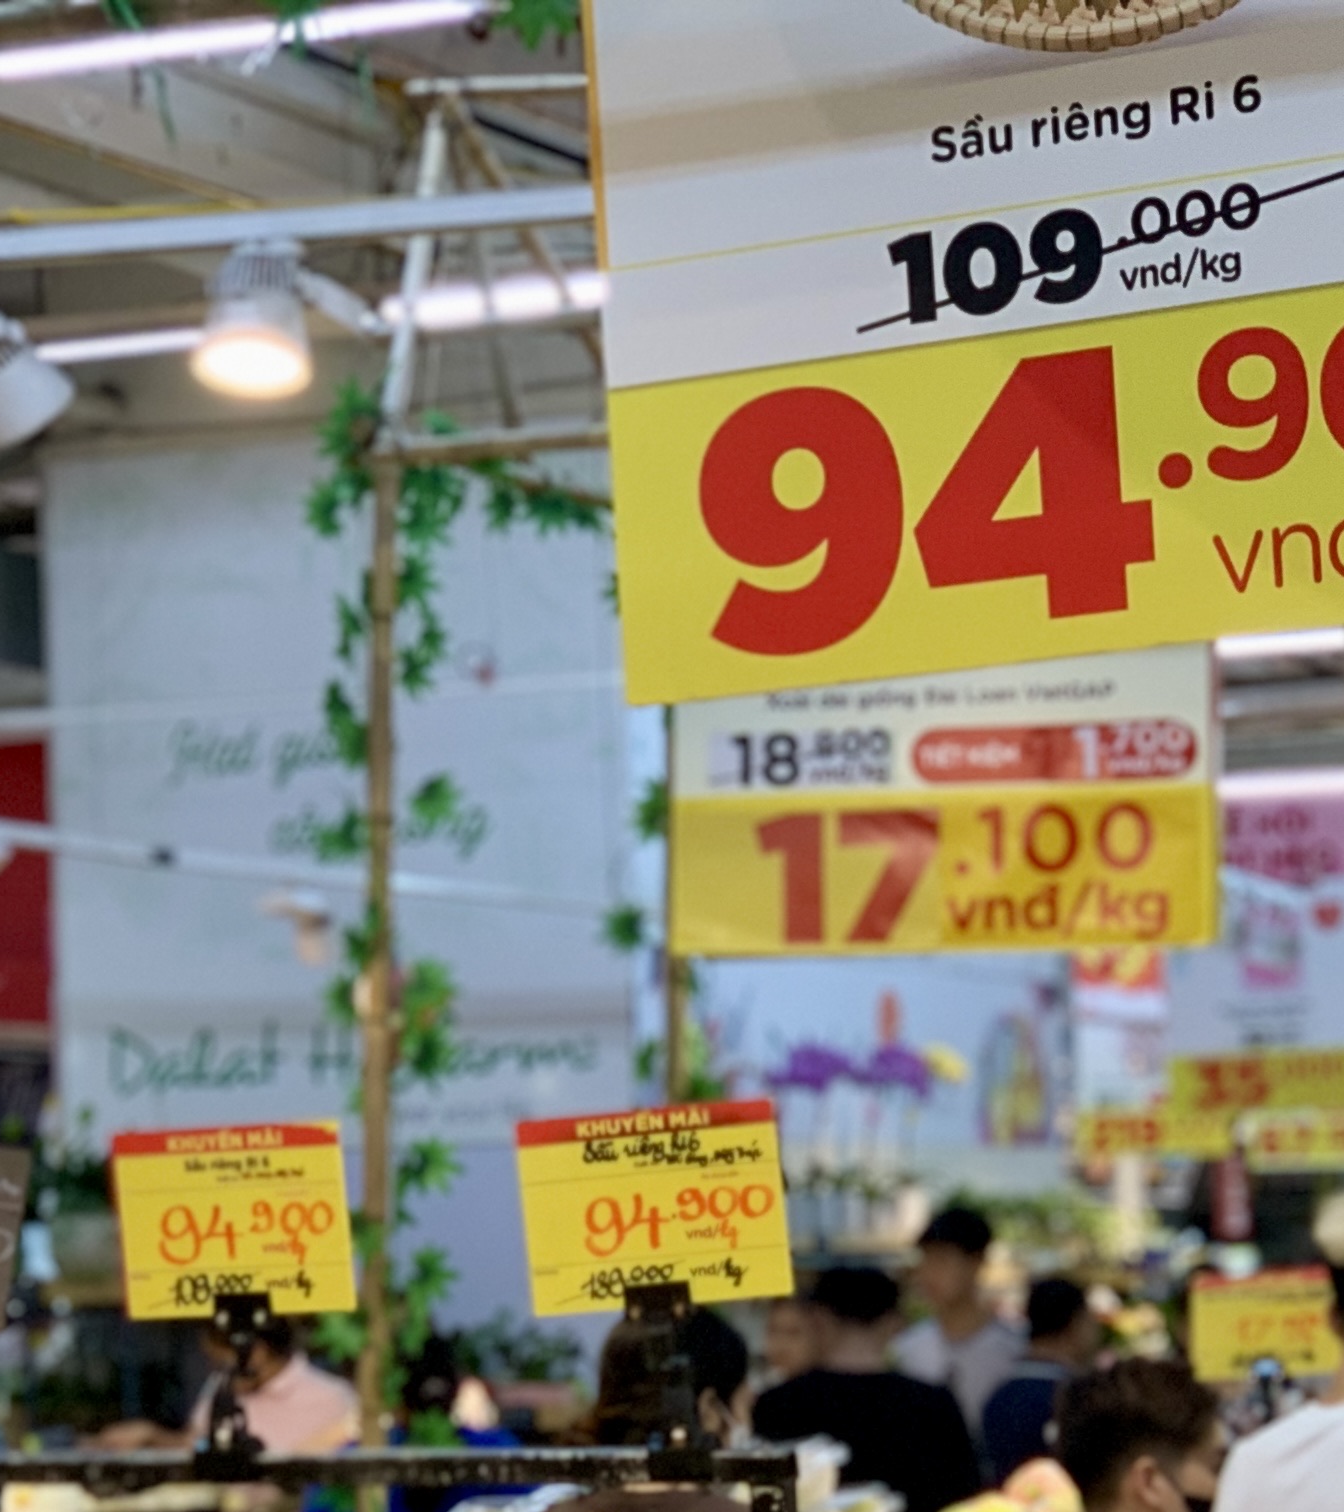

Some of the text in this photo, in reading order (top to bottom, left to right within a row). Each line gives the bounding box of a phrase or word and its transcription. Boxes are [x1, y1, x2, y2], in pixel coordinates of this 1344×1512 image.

[931, 74, 1262, 163] Sầu riêng Ri 6
[887, 182, 1261, 325] 109.000
[1119, 247, 1243, 292] vnd/kg
[575, 1110, 666, 1139] KHUYẾN
